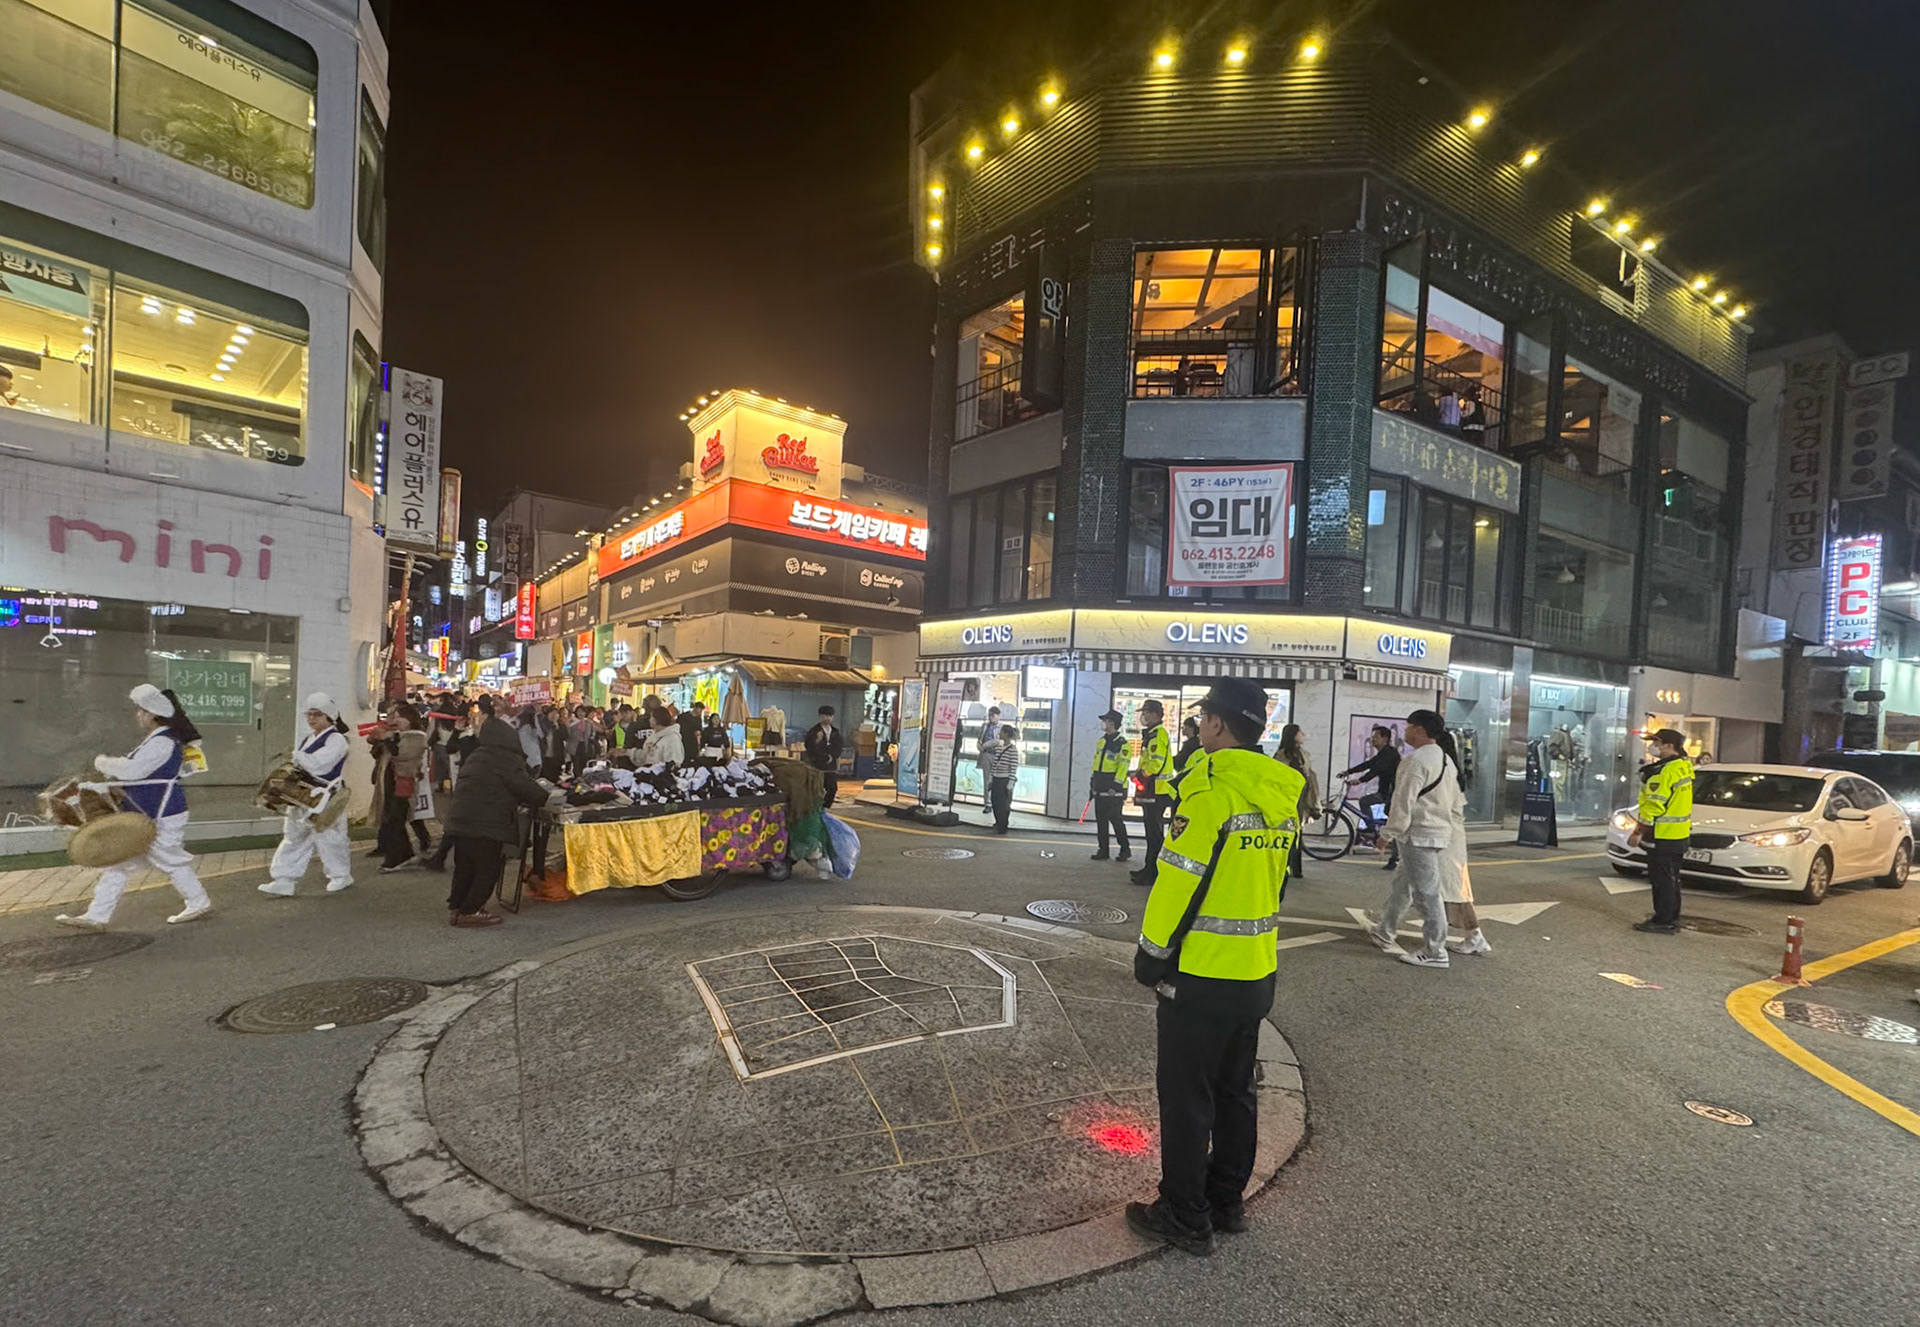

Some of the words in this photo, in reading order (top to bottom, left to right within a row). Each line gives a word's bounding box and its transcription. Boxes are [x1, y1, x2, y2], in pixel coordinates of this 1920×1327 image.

[777, 433, 807, 450] Red
[400, 411, 427, 530] 헤어플러스유
[1190, 478, 1205, 487] 2F
[1213, 477, 1245, 487] 46PY
[788, 500, 908, 548] 보드게임카페
[1190, 496, 1272, 537] 임대
[48, 514, 274, 581] mini
[1182, 545, 1275, 560] 062.413.2248
[1836, 618, 1868, 627] CLUB
[962, 624, 1012, 645] OLENS
[1166, 622, 1248, 644] OLENS
[1842, 632, 1861, 640] 2F
[1377, 633, 1427, 658] OLENS
[175, 669, 247, 688] 상가임대
[1239, 835, 1290, 850] POCE
